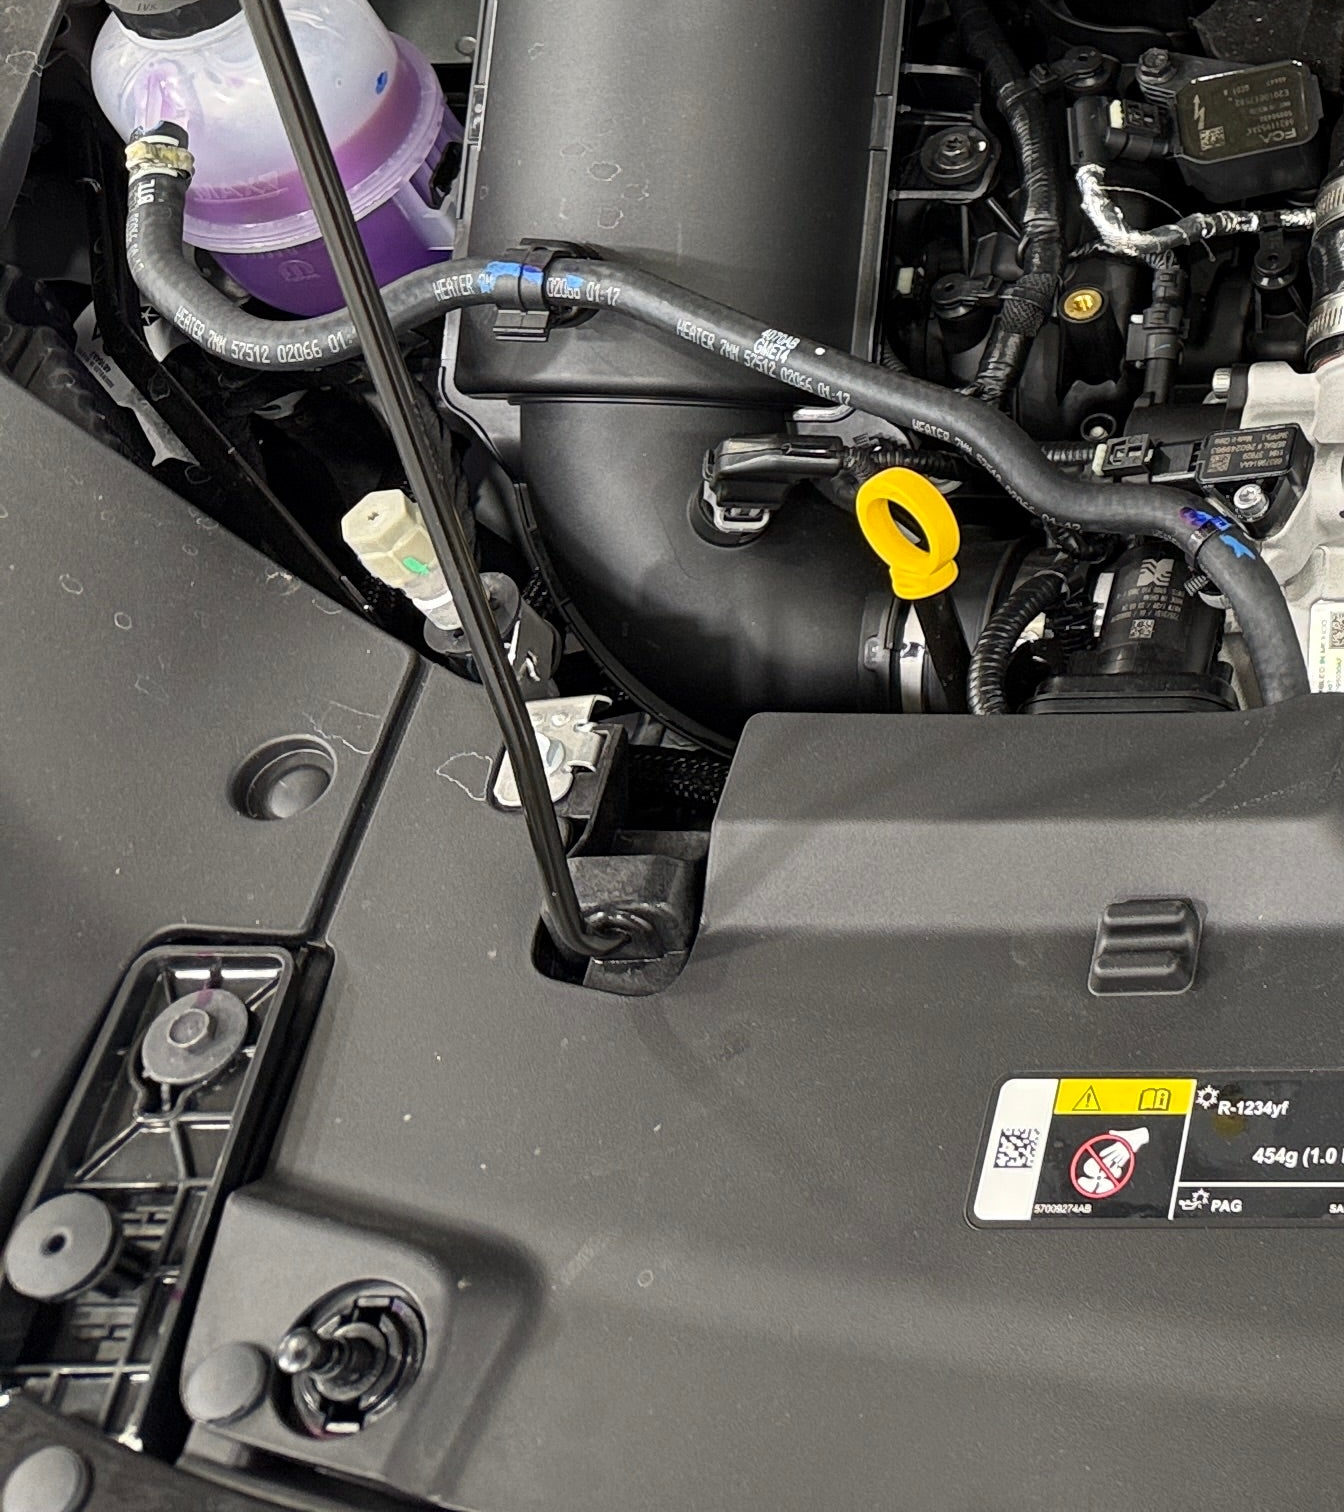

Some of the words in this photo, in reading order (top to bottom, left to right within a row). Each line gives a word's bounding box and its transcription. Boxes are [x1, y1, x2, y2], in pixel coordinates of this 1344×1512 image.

[1259, 128, 1296, 143] FCA
[432, 274, 474, 301] HEATER
[676, 318, 715, 351] HEATER
[1217, 1099, 1289, 1119] R-1234yf
[1251, 1146, 1299, 1169] 454g
[1302, 1146, 1338, 1169] (1.0
[1210, 1199, 1242, 1213] PAG
